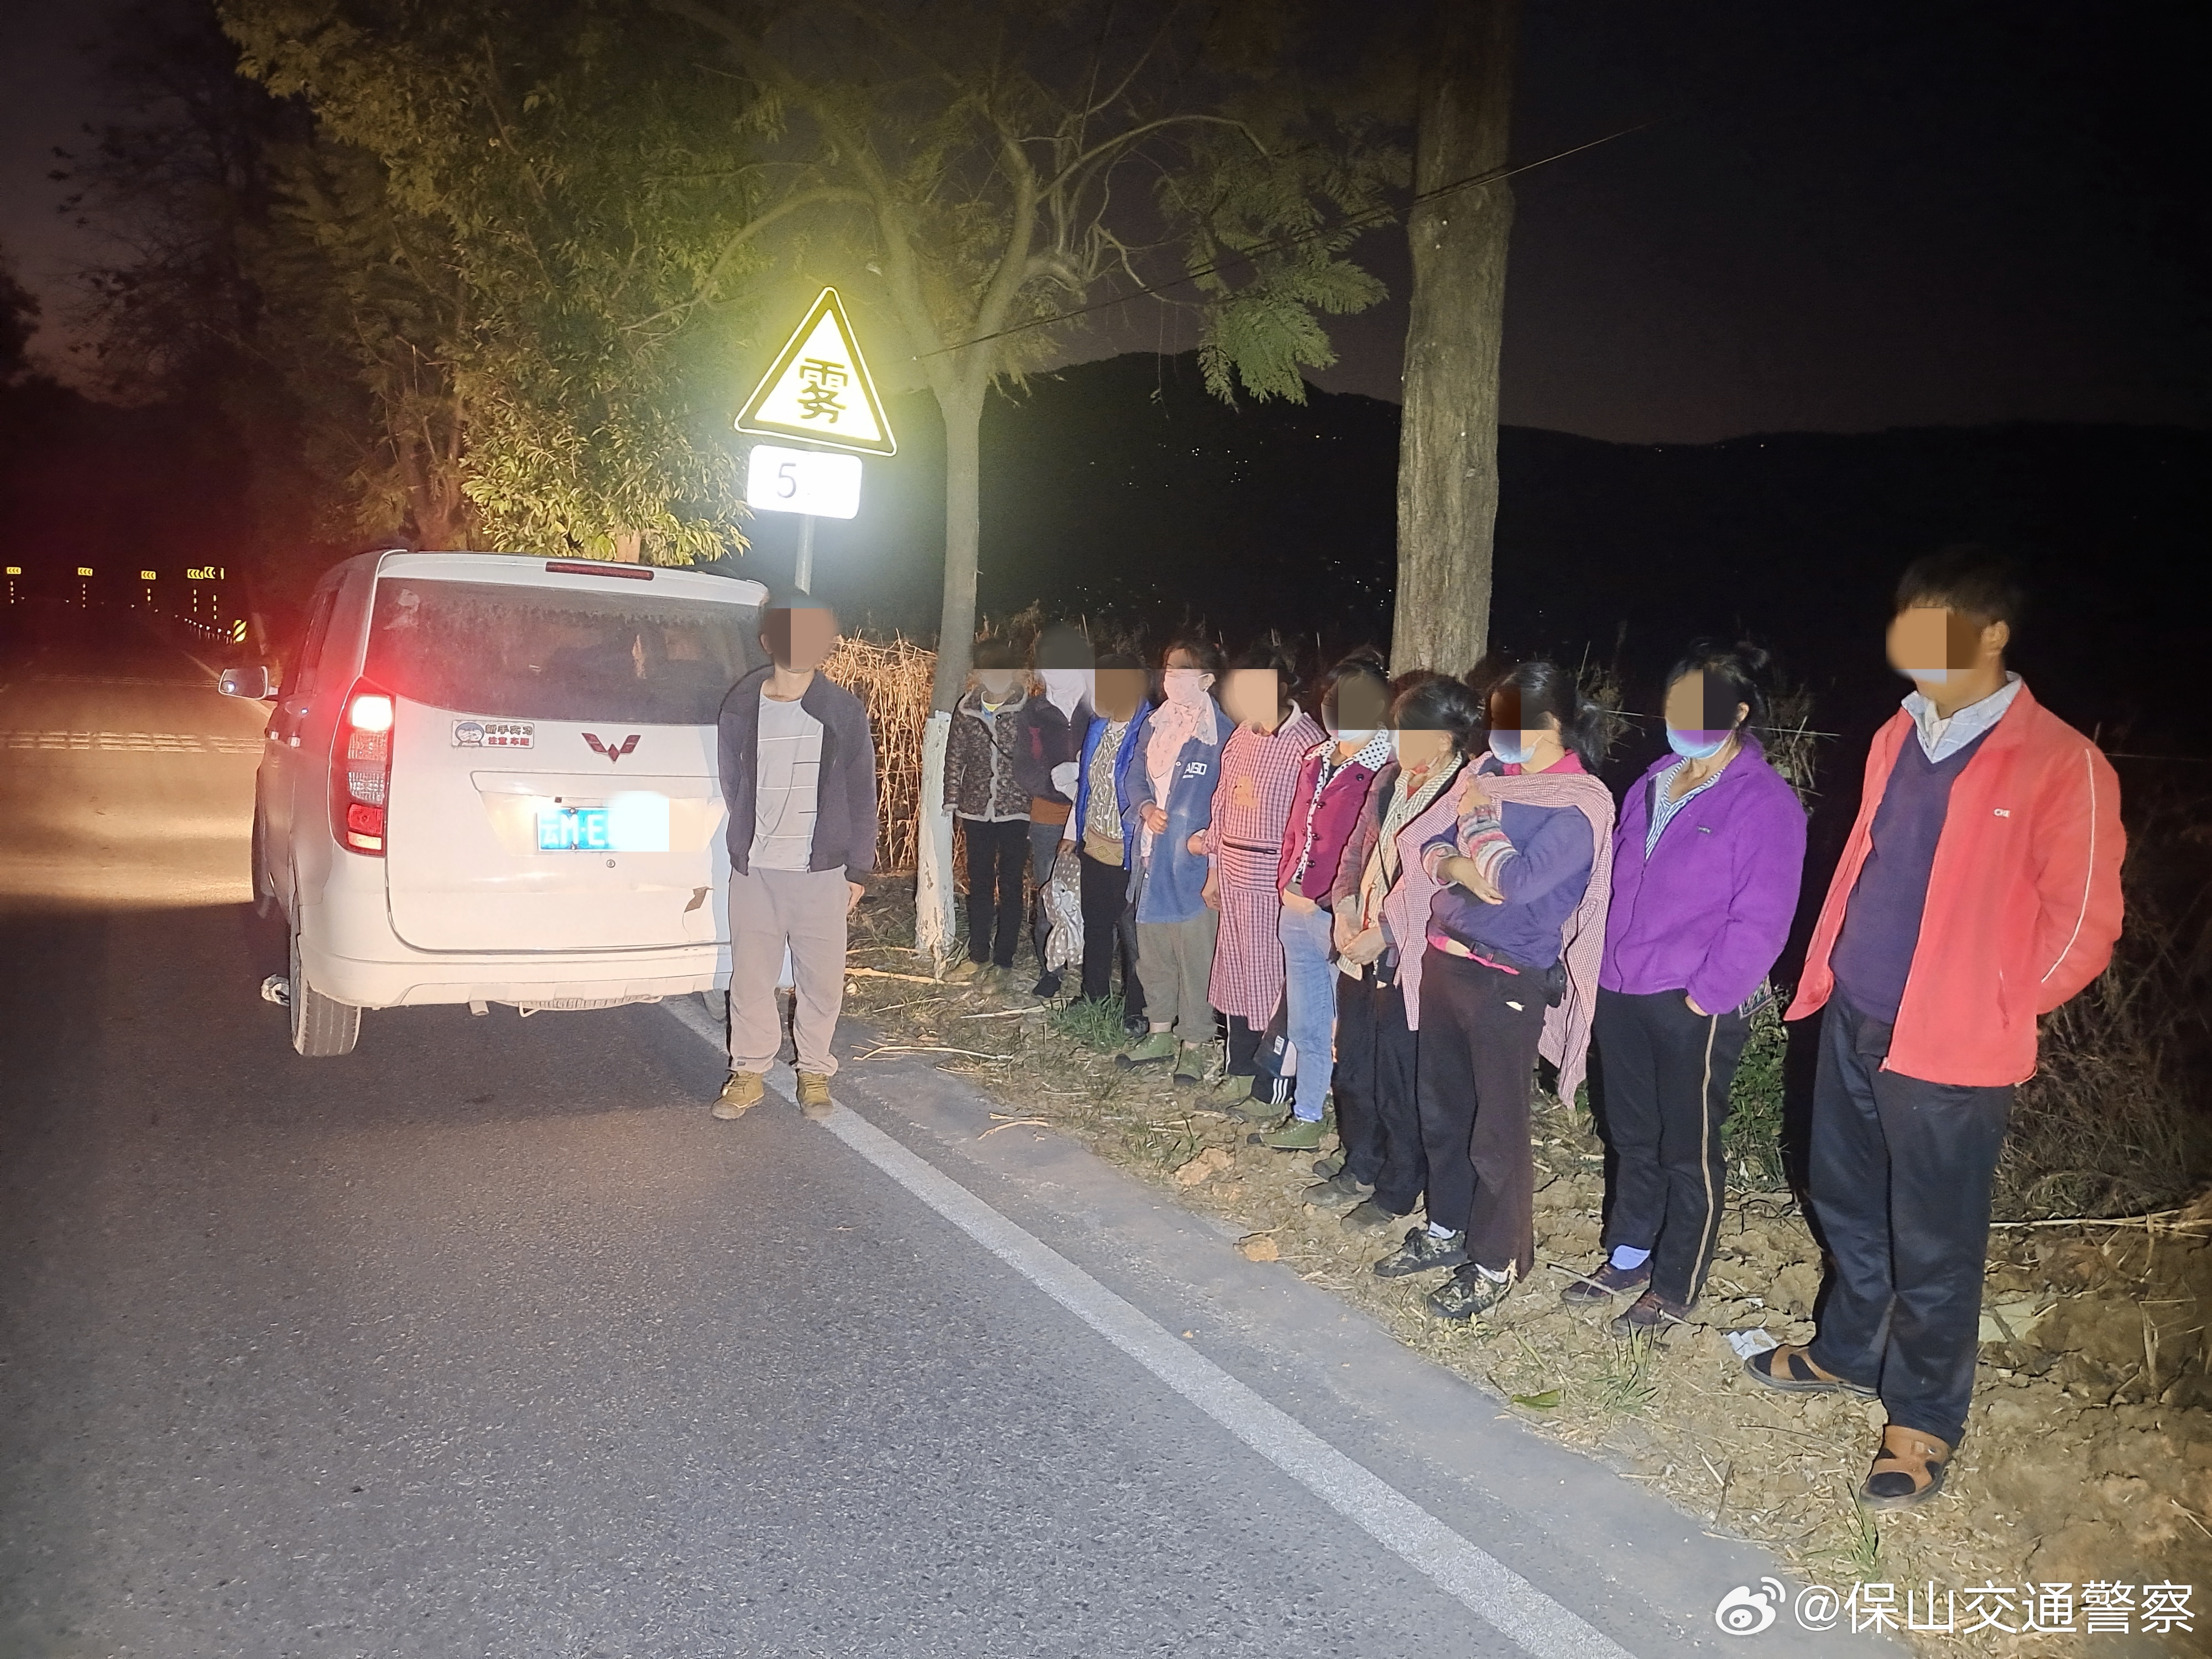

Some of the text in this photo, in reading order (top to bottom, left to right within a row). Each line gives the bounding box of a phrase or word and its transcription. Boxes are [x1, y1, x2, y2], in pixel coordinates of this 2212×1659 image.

[797, 358, 848, 424] 雾
[776, 462, 796, 498] 5
[485, 724, 533, 735] 新手实习
